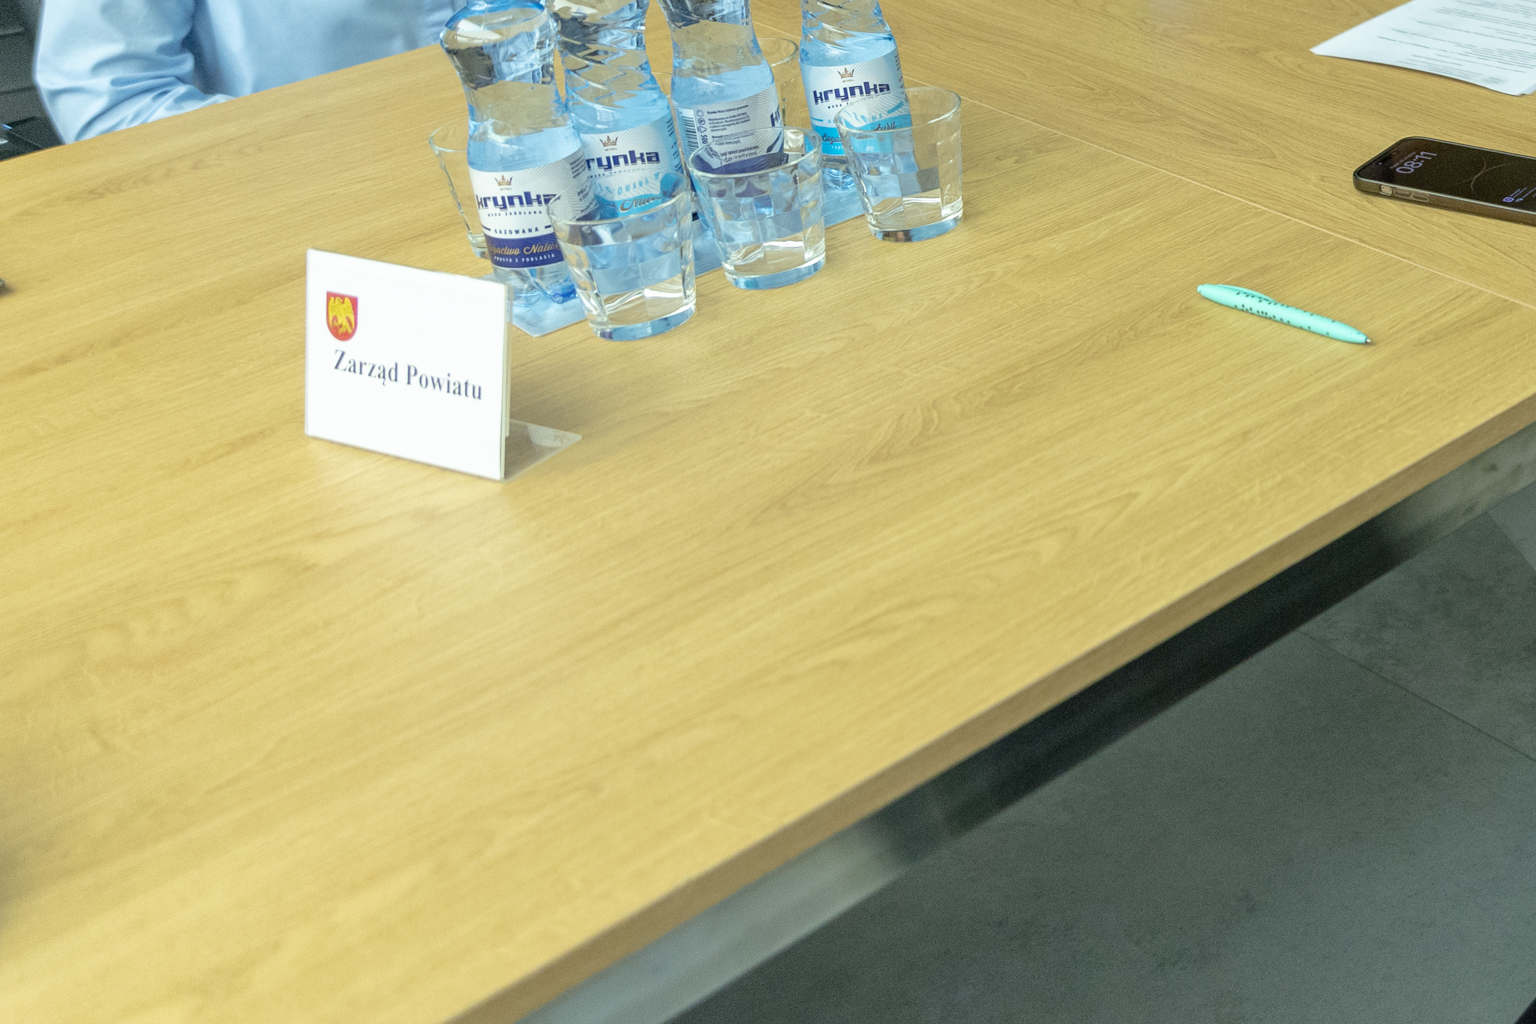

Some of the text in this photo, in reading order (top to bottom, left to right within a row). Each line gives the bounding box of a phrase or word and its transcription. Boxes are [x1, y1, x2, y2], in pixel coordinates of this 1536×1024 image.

[813, 81, 891, 106] krynka
[1395, 151, 1438, 174] 08:11
[475, 190, 560, 210] krynka
[494, 226, 540, 235] GAZOWANA
[334, 349, 483, 401] Zarząd Powiatu
